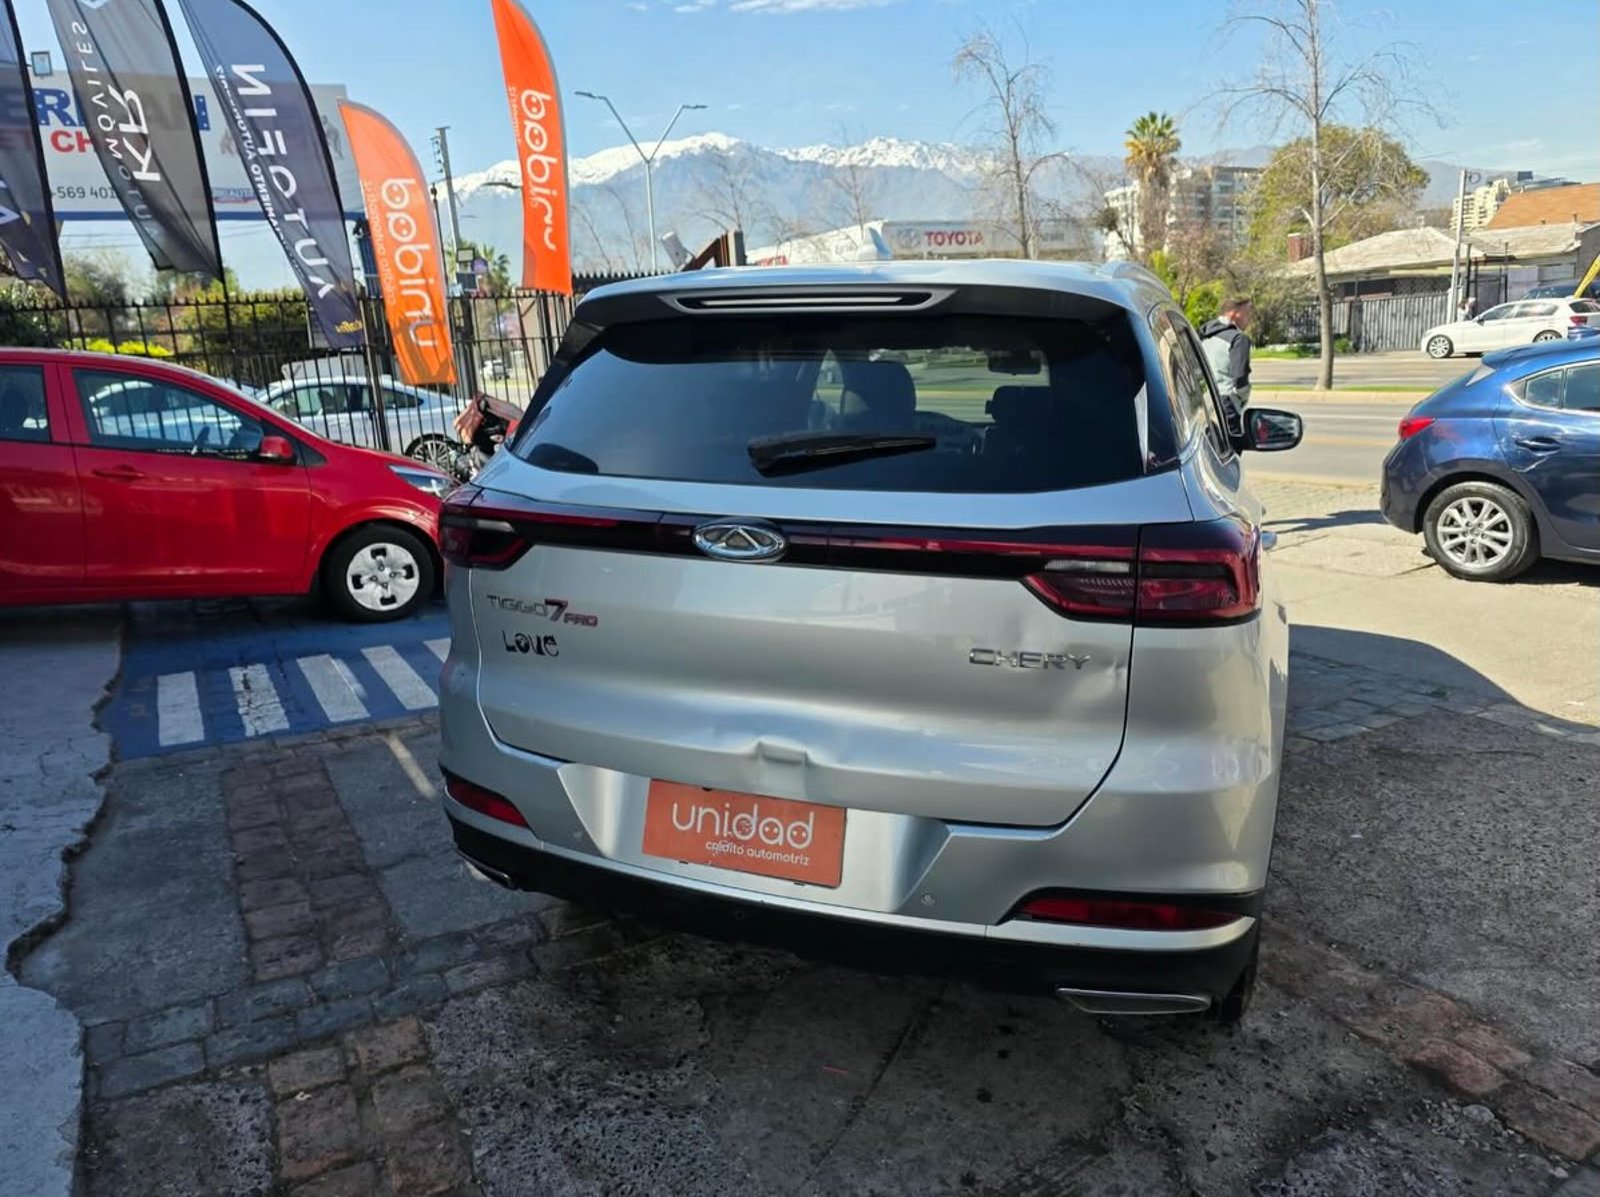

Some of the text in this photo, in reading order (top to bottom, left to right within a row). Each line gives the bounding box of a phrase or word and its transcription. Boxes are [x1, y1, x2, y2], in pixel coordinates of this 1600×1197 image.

[924, 230, 984, 247] TOYOTA
[487, 594, 599, 628] TIGGO 7 PRO
[969, 648, 1091, 670] CHERY
[672, 802, 815, 850] unidad
[746, 847, 810, 866] automotriz
